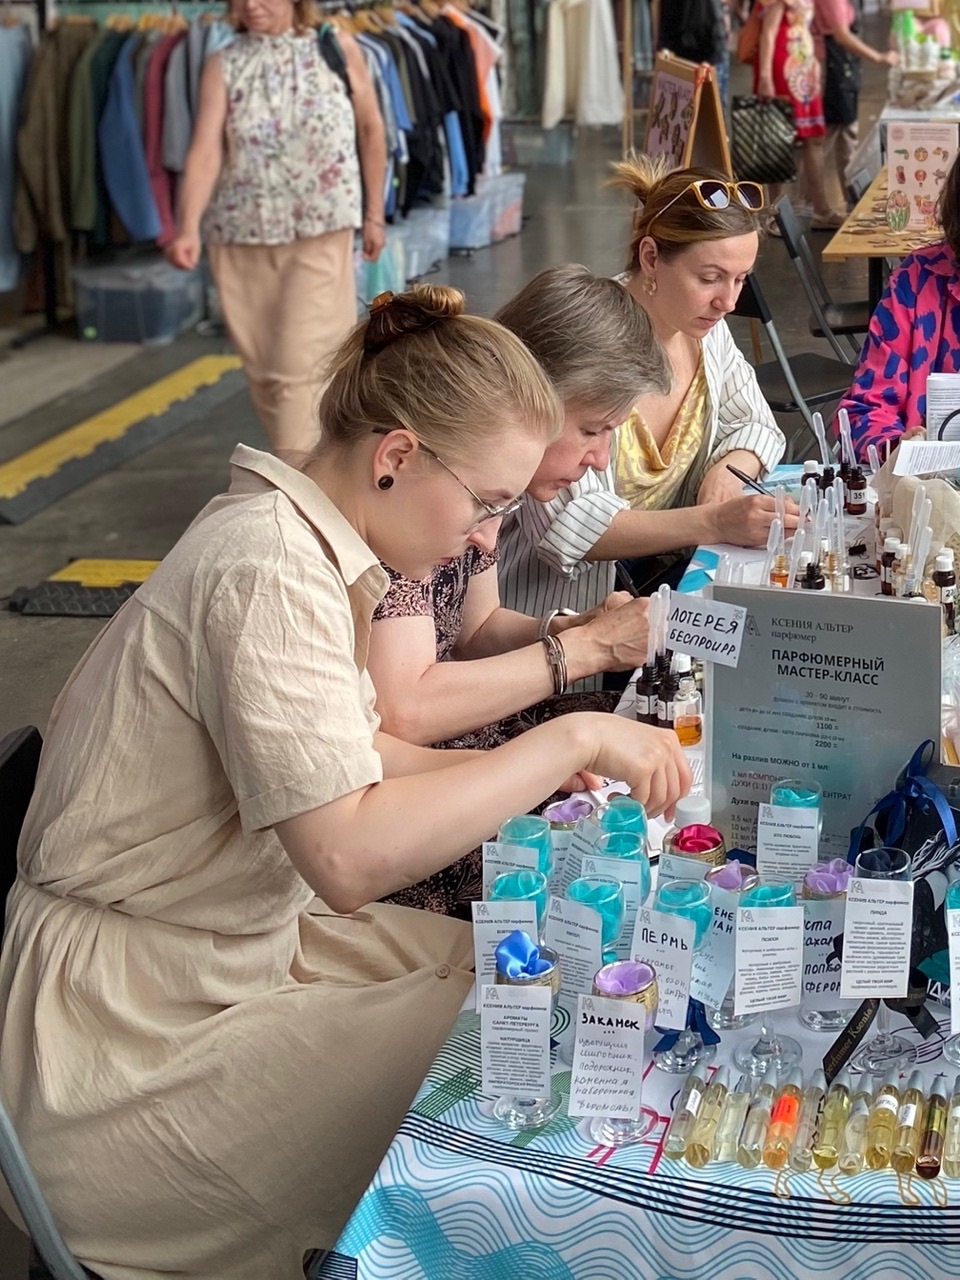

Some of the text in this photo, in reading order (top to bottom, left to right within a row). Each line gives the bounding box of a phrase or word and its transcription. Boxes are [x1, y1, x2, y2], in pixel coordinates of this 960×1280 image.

[670, 607, 738, 635] ЛОТЕРЕЯ
[771, 617, 854, 634] КСЕНИЯ АЛЬТЕР
[771, 630, 817, 643] парфюмер
[771, 648, 885, 672] ПАРФЮМЕРНЫЙ
[777, 664, 879, 686] МАСТЕР-КЛАСС
[819, 693, 829, 701] 90
[815, 740, 832, 748] 2200
[731, 752, 741, 760] На
[743, 754, 769, 763] разлив
[770, 756, 800, 767] МОЖНО
[731, 779, 751, 787] ДУХИ
[730, 796, 749, 804] Духи
[641, 927, 688, 950] ПЕРМЬ
